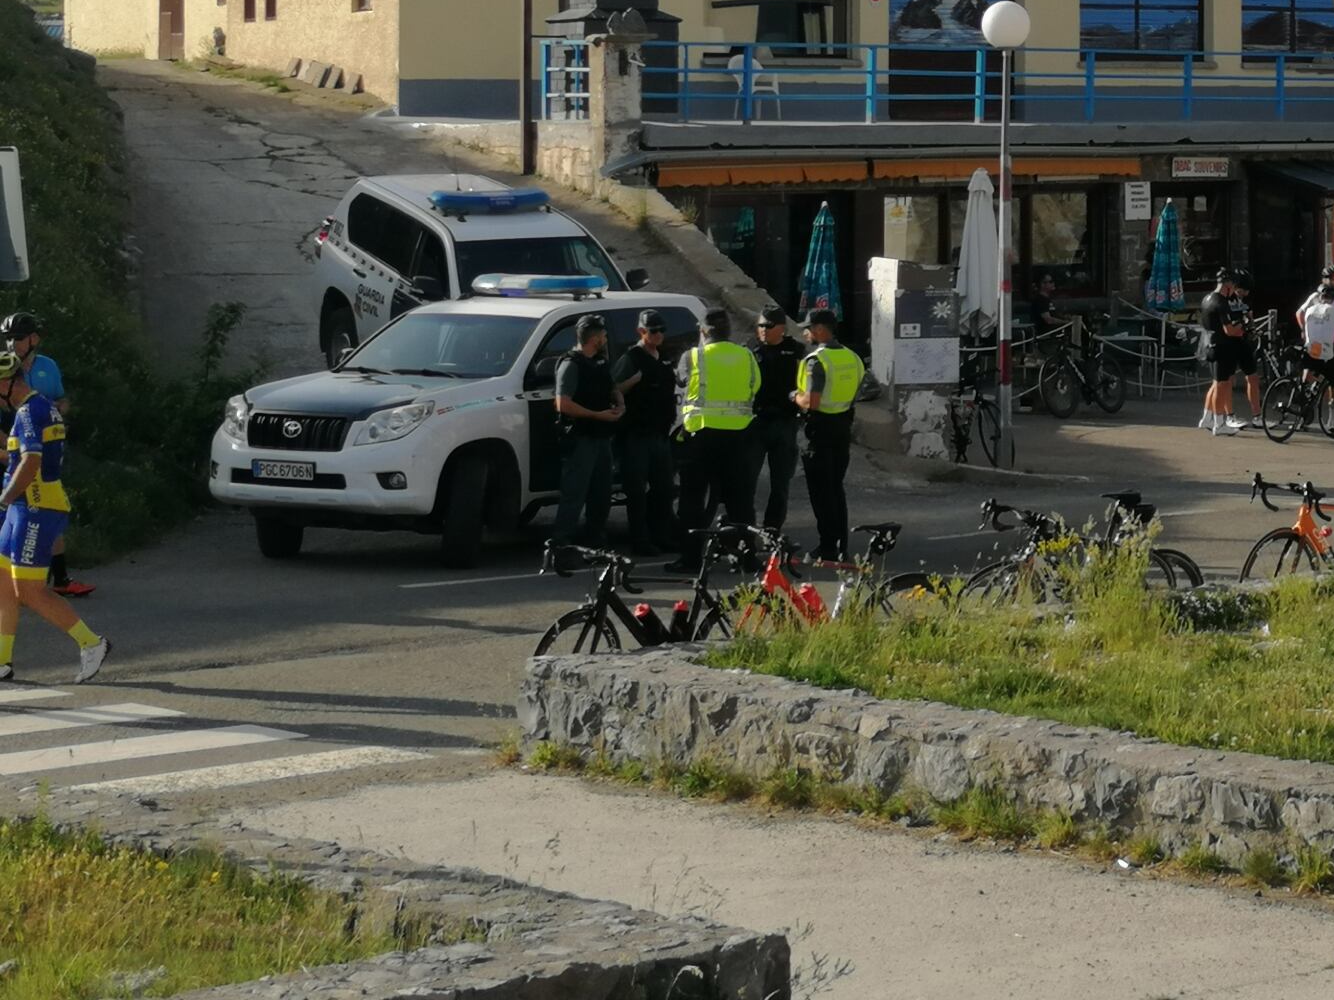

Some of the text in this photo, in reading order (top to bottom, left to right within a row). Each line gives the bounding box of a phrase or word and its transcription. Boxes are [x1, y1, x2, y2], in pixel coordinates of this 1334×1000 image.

[358, 283, 385, 305] GUARDIA
[362, 301, 379, 318] CIVIL
[20, 521, 40, 565] PERBIKE
